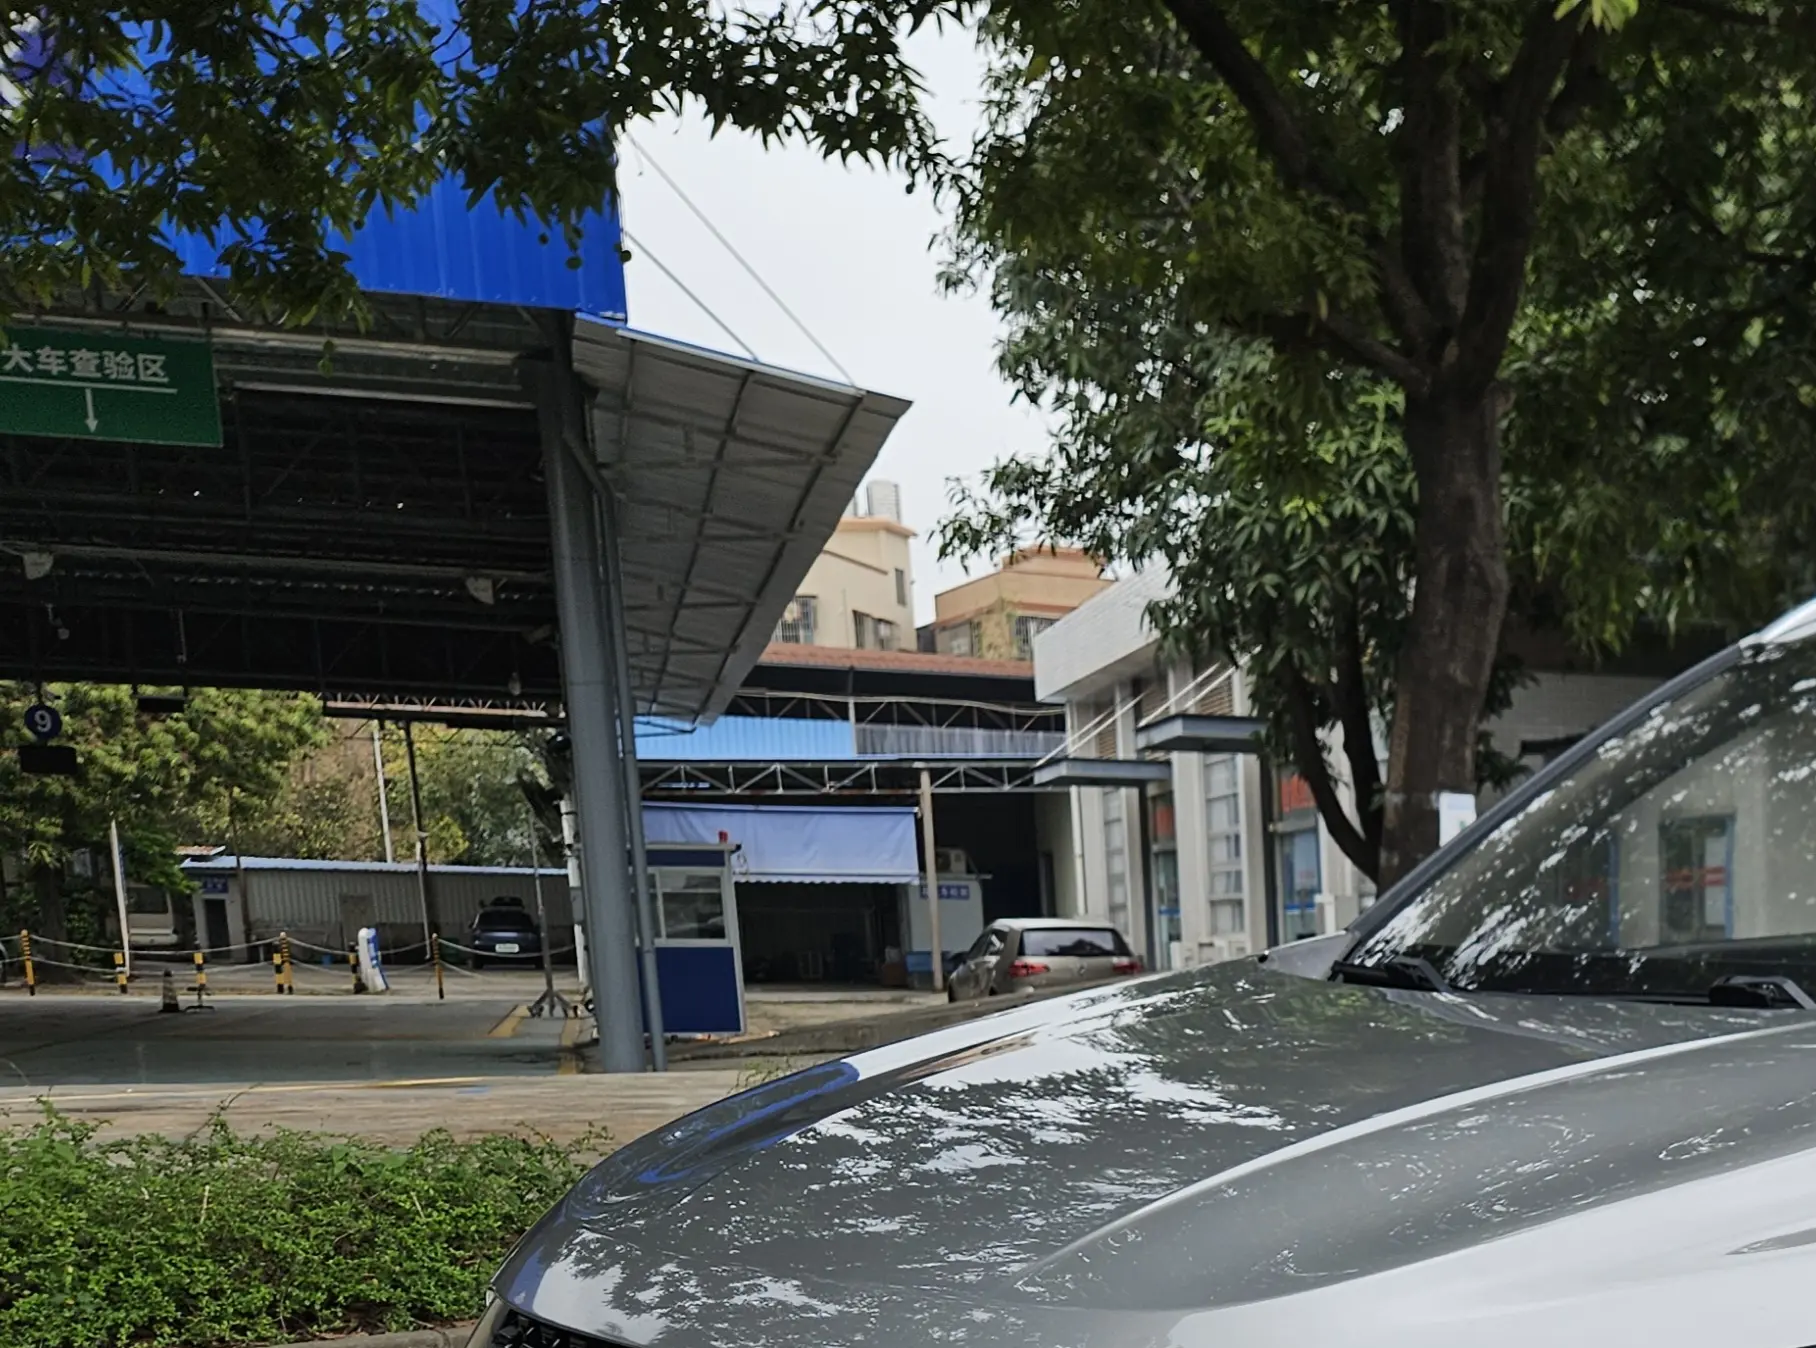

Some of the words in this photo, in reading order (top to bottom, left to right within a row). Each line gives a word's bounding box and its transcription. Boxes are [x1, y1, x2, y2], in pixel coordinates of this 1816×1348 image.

[2, 342, 170, 384] 大车查验区
[34, 709, 53, 733] 9
